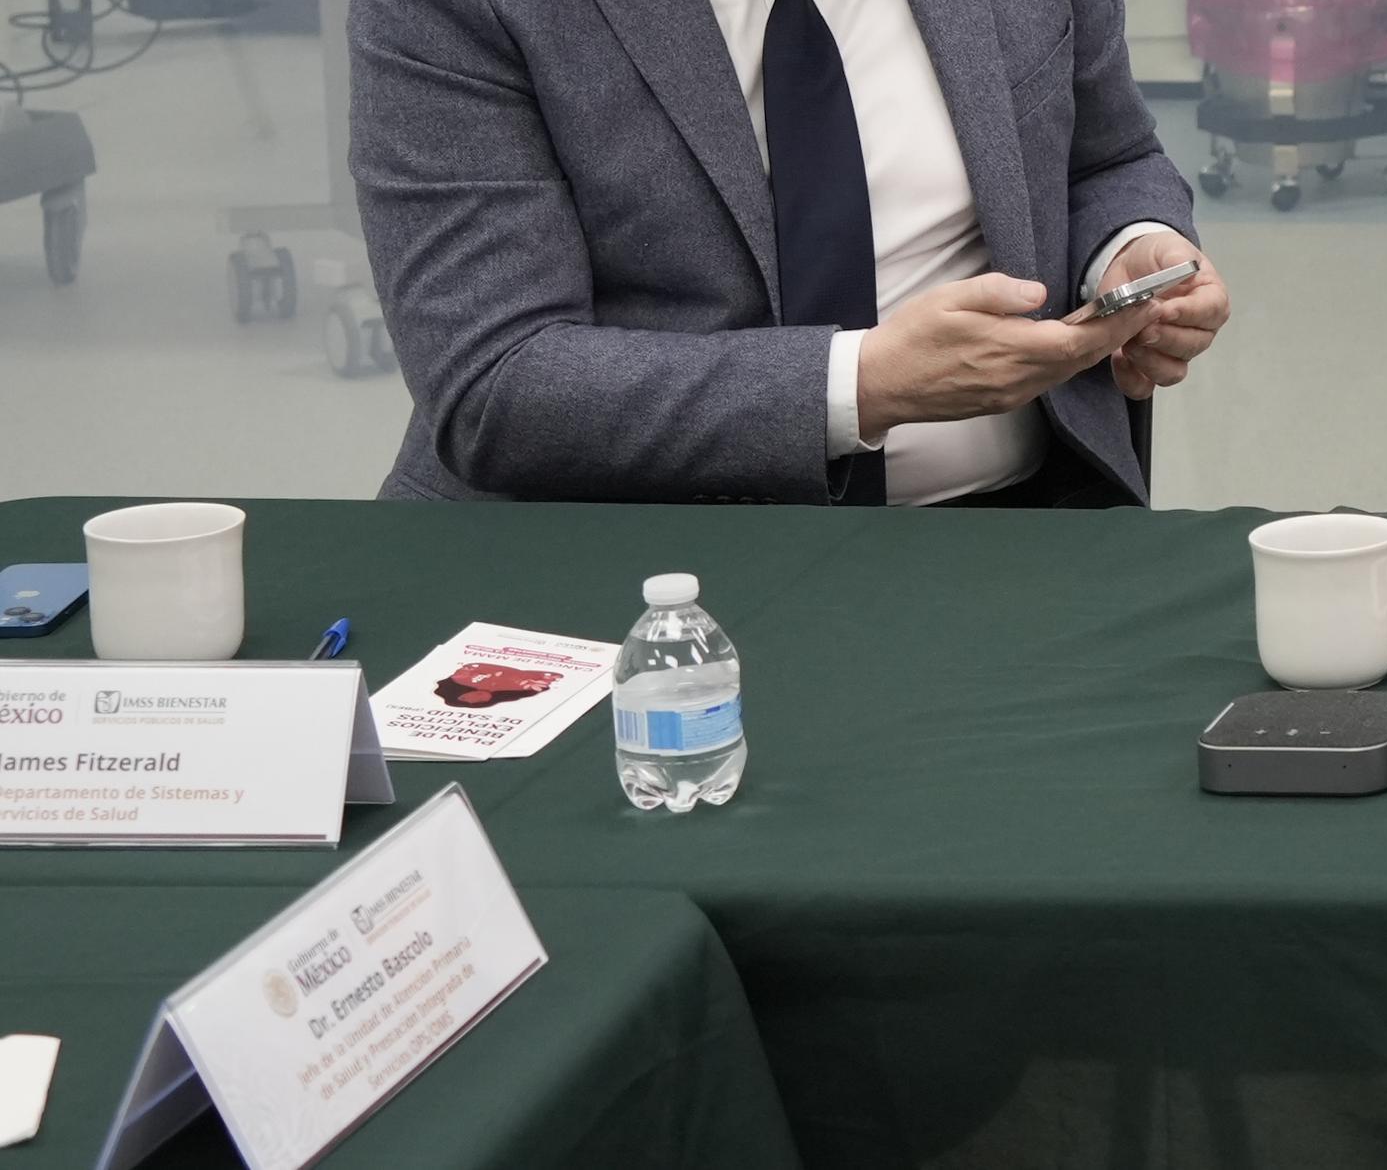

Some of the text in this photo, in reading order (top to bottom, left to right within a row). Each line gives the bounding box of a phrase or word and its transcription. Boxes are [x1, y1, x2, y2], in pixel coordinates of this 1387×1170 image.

[464, 649, 510, 661] MAMA
[0, 690, 67, 702] bierno de
[123, 697, 227, 708] IMSS BIENESTAR
[0, 703, 63, 724] éxico
[427, 710, 523, 725] DE SALUD
[387, 721, 505, 739] BENEFICIOS
[408, 731, 496, 746] PLAN DE
[76, 753, 181, 771] Fitzerald
[125, 786, 146, 800] de
[151, 786, 229, 800] Sistemas
[234, 788, 244, 804] y
[0, 807, 139, 821] rvicios de Salud
[295, 945, 352, 997] México
[308, 931, 433, 1040] Dr. Ernesto Bascolo
